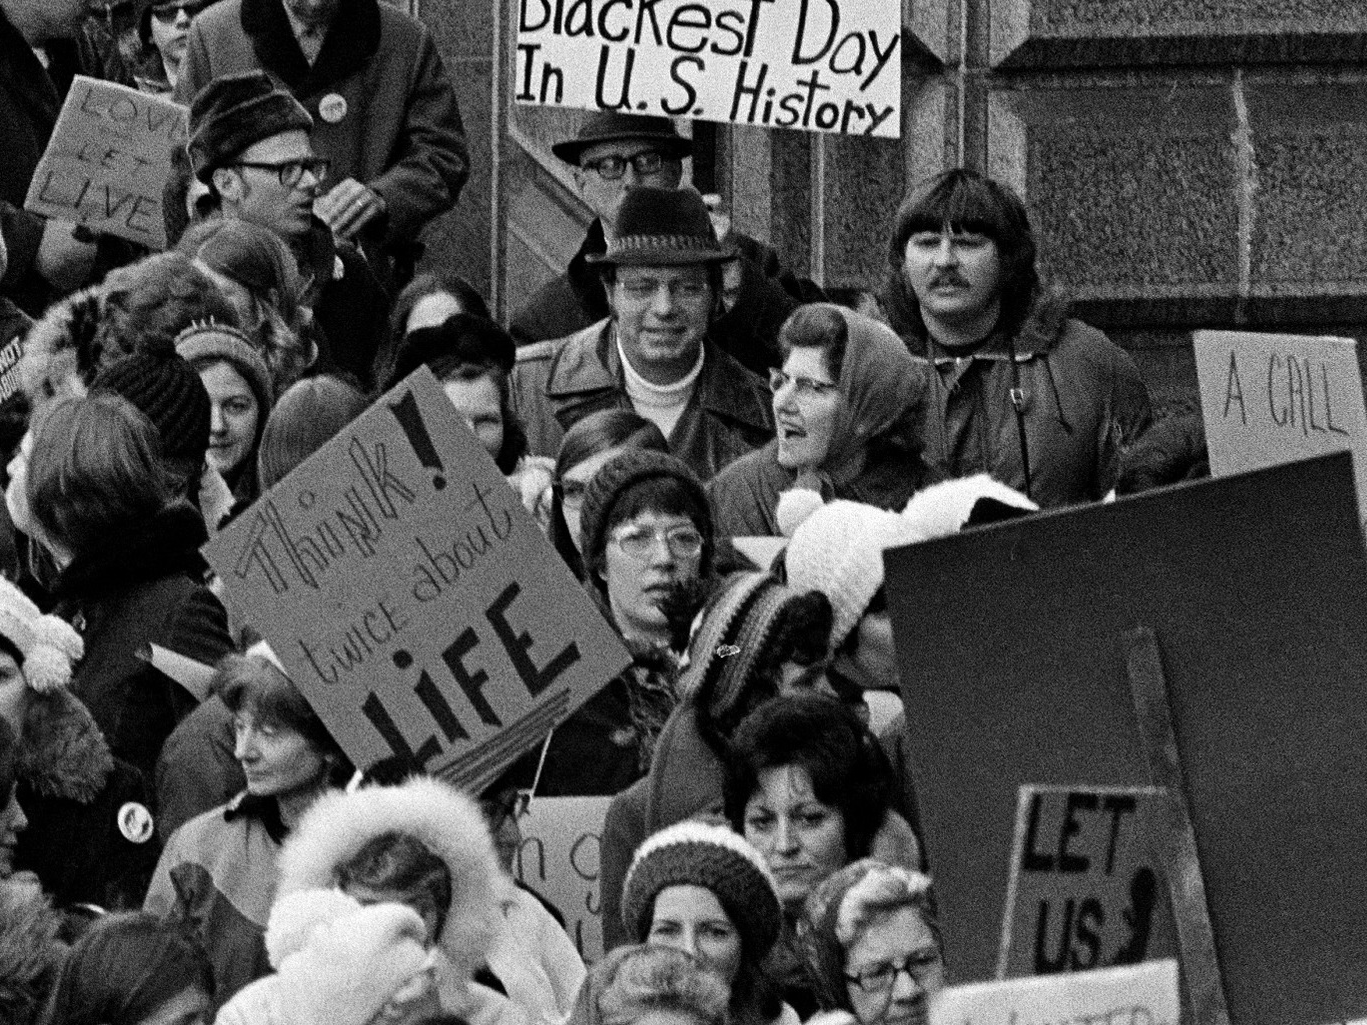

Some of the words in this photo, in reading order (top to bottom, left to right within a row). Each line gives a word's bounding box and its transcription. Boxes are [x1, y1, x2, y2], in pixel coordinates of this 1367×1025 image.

[516, 43, 564, 104] In
[729, 59, 895, 135] History
[38, 170, 158, 234] LIVE
[76, 143, 154, 179] LET
[1224, 349, 1247, 425] A
[1268, 351, 1350, 438] CALL
[411, 482, 513, 604] about
[1022, 790, 1137, 876] LET
